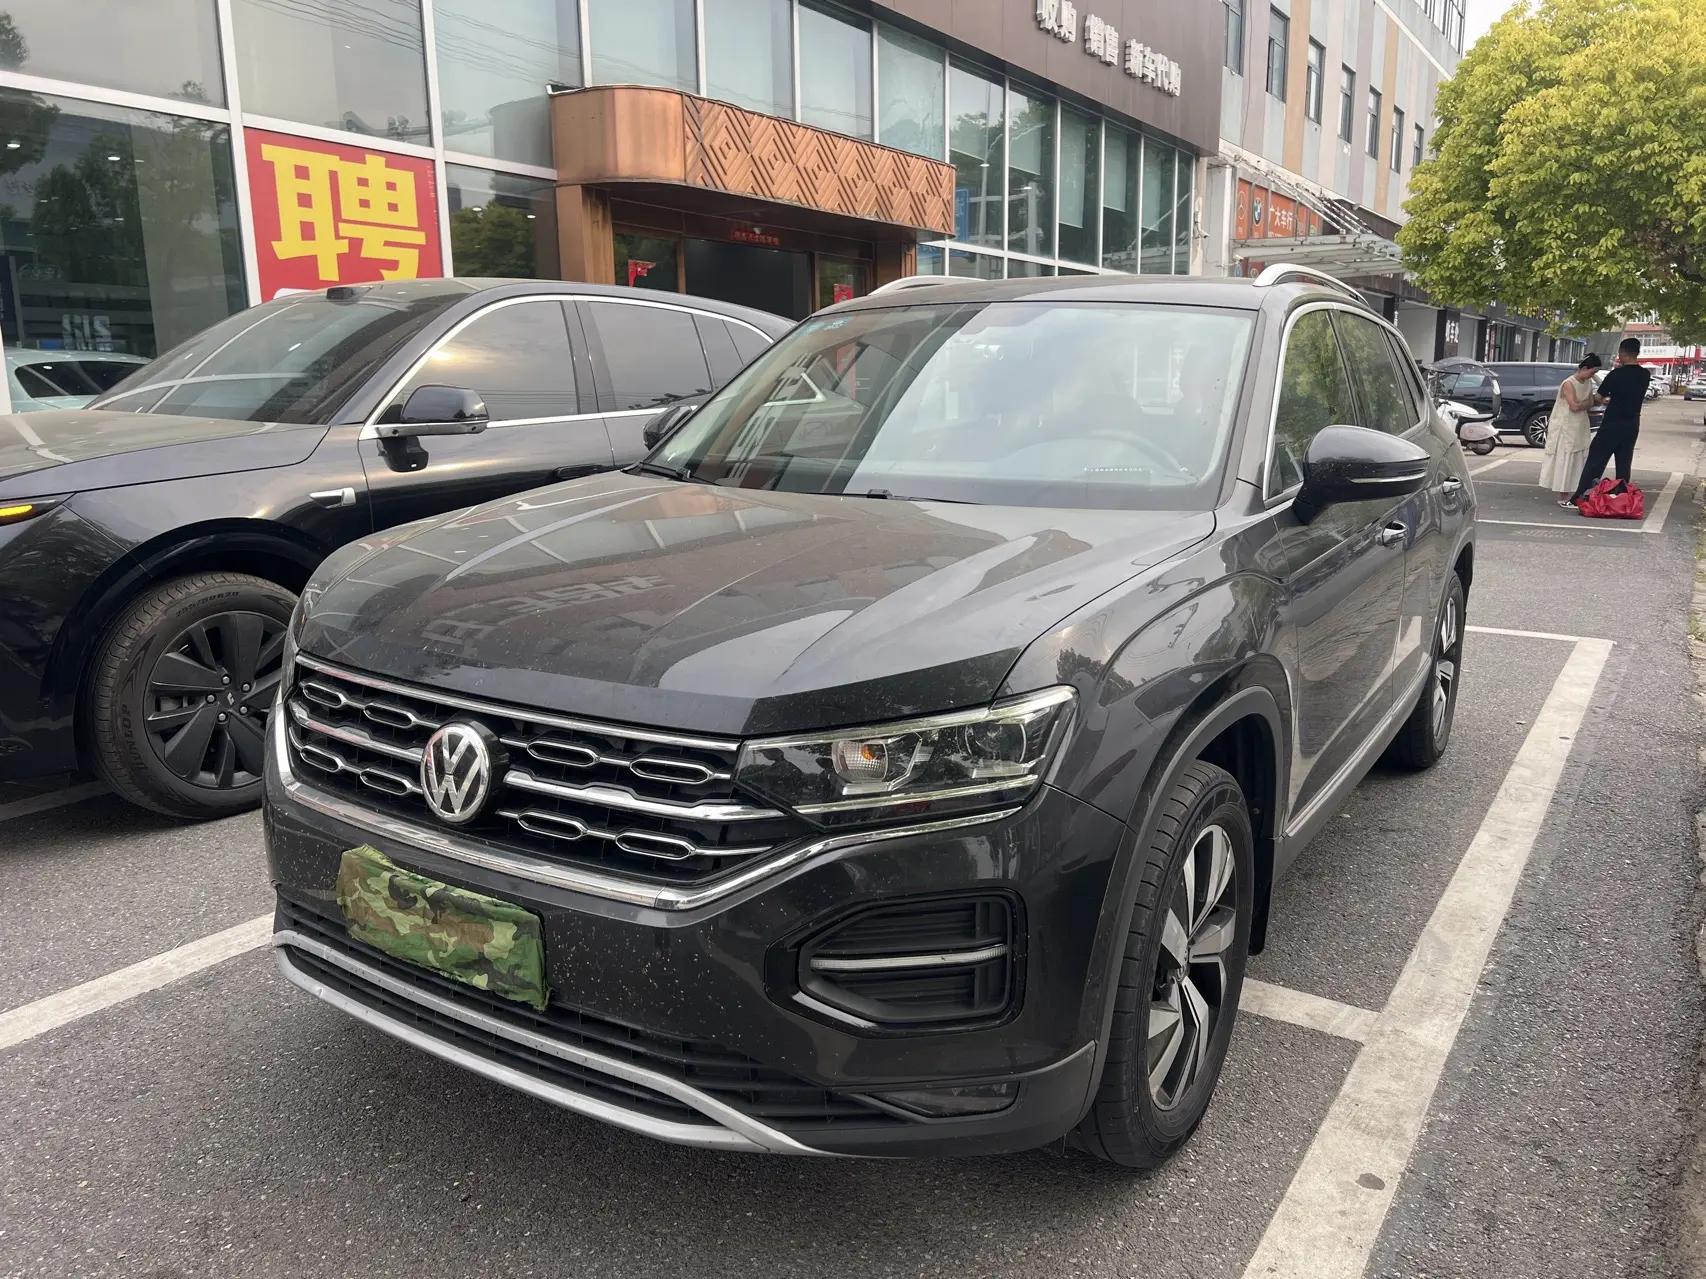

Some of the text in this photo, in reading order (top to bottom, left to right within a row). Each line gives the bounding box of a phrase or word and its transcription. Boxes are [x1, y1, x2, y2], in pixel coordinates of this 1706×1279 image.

[1085, 14, 1119, 65] 销售
[1125, 38, 1181, 96] 新车代购
[261, 143, 426, 281] 聘
